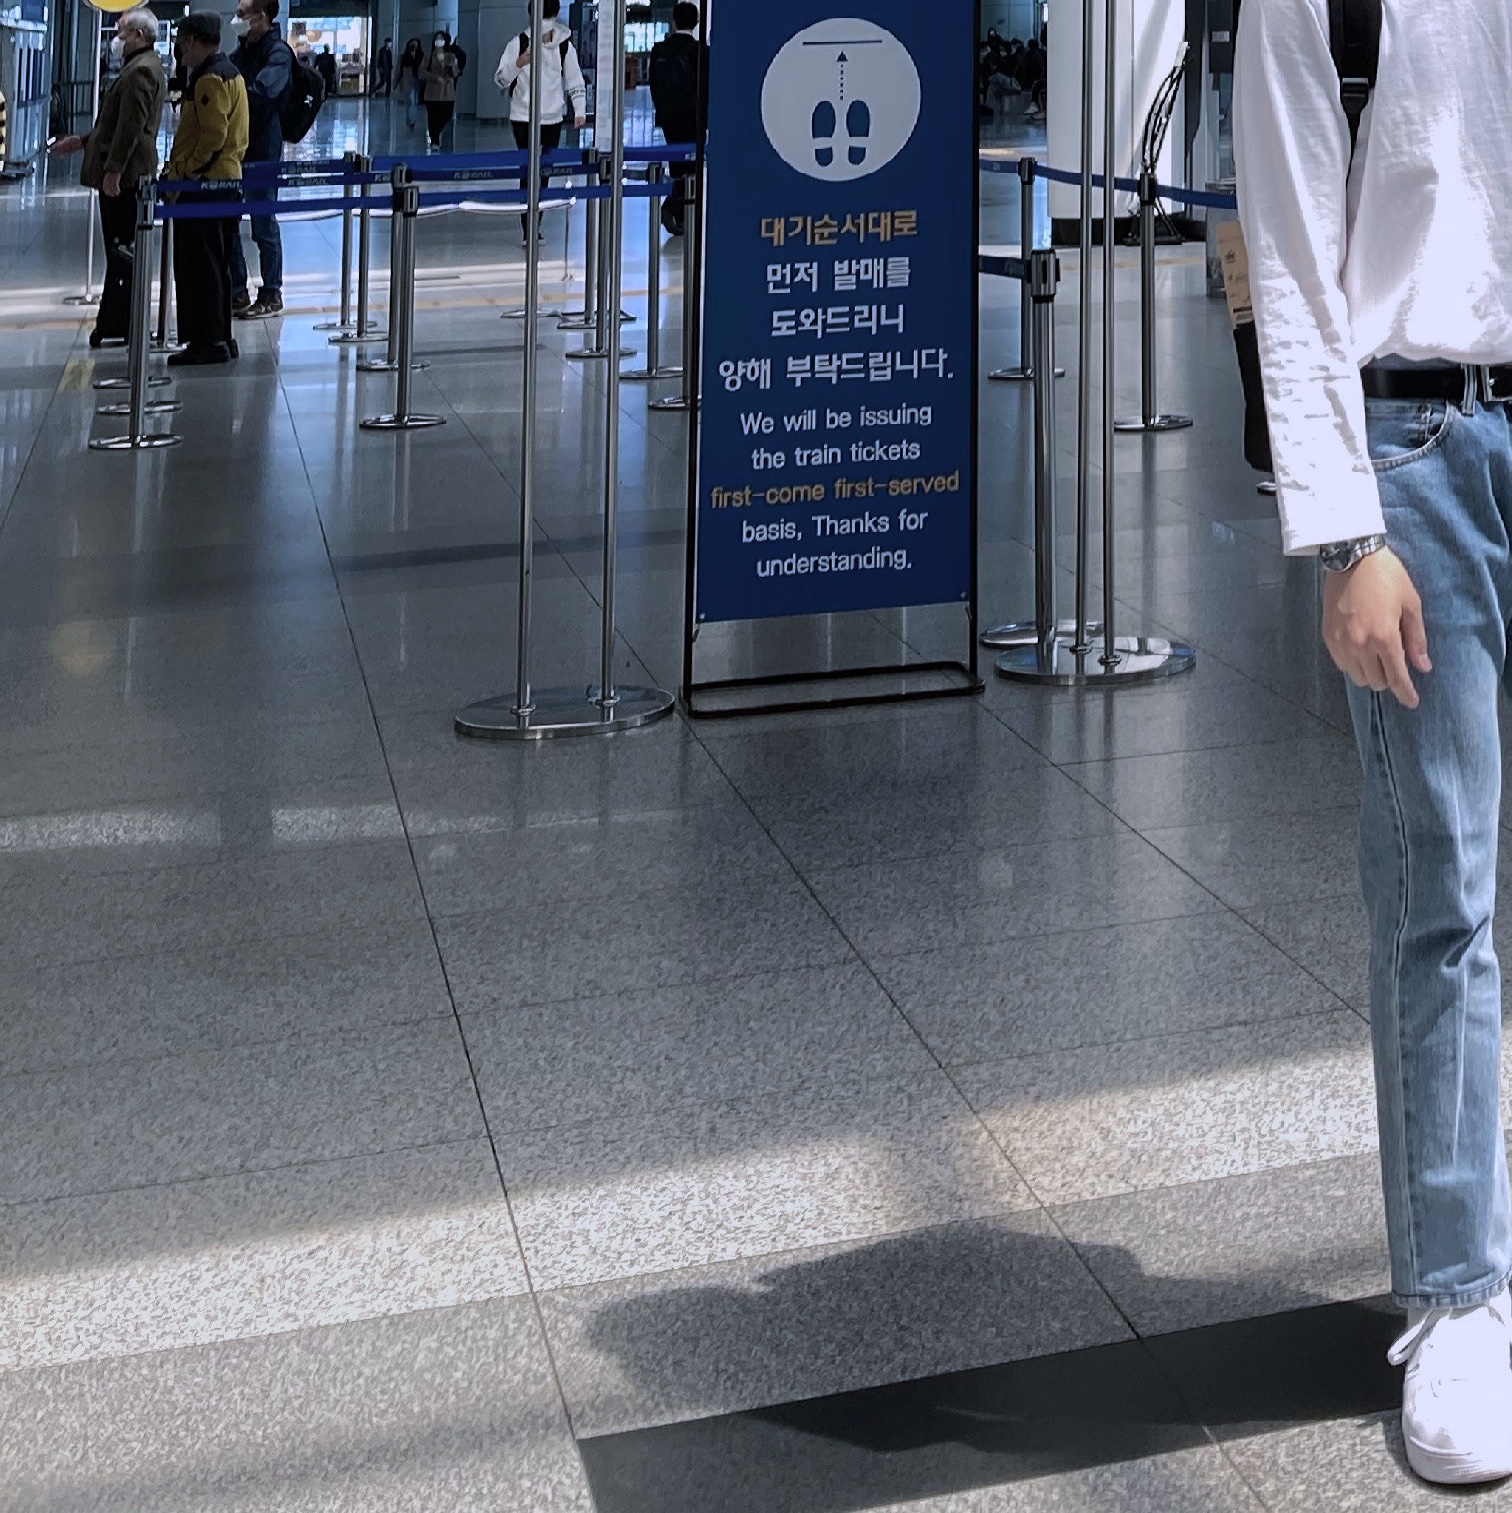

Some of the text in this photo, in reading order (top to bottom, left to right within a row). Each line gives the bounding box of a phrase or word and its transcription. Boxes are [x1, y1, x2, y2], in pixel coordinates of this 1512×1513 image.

[762, 210, 917, 246] 대기순서대로
[767, 257, 910, 293] 먼저 발매를
[772, 304, 903, 338] 도와드리니
[719, 348, 953, 391] 양해 부탁드립니다.
[741, 403, 931, 435] We will be issuing
[751, 440, 920, 469] the train tickets
[711, 470, 959, 508] first-come first-served
[743, 509, 928, 542] basis, Thanks for
[757, 546, 911, 577] understanding.
